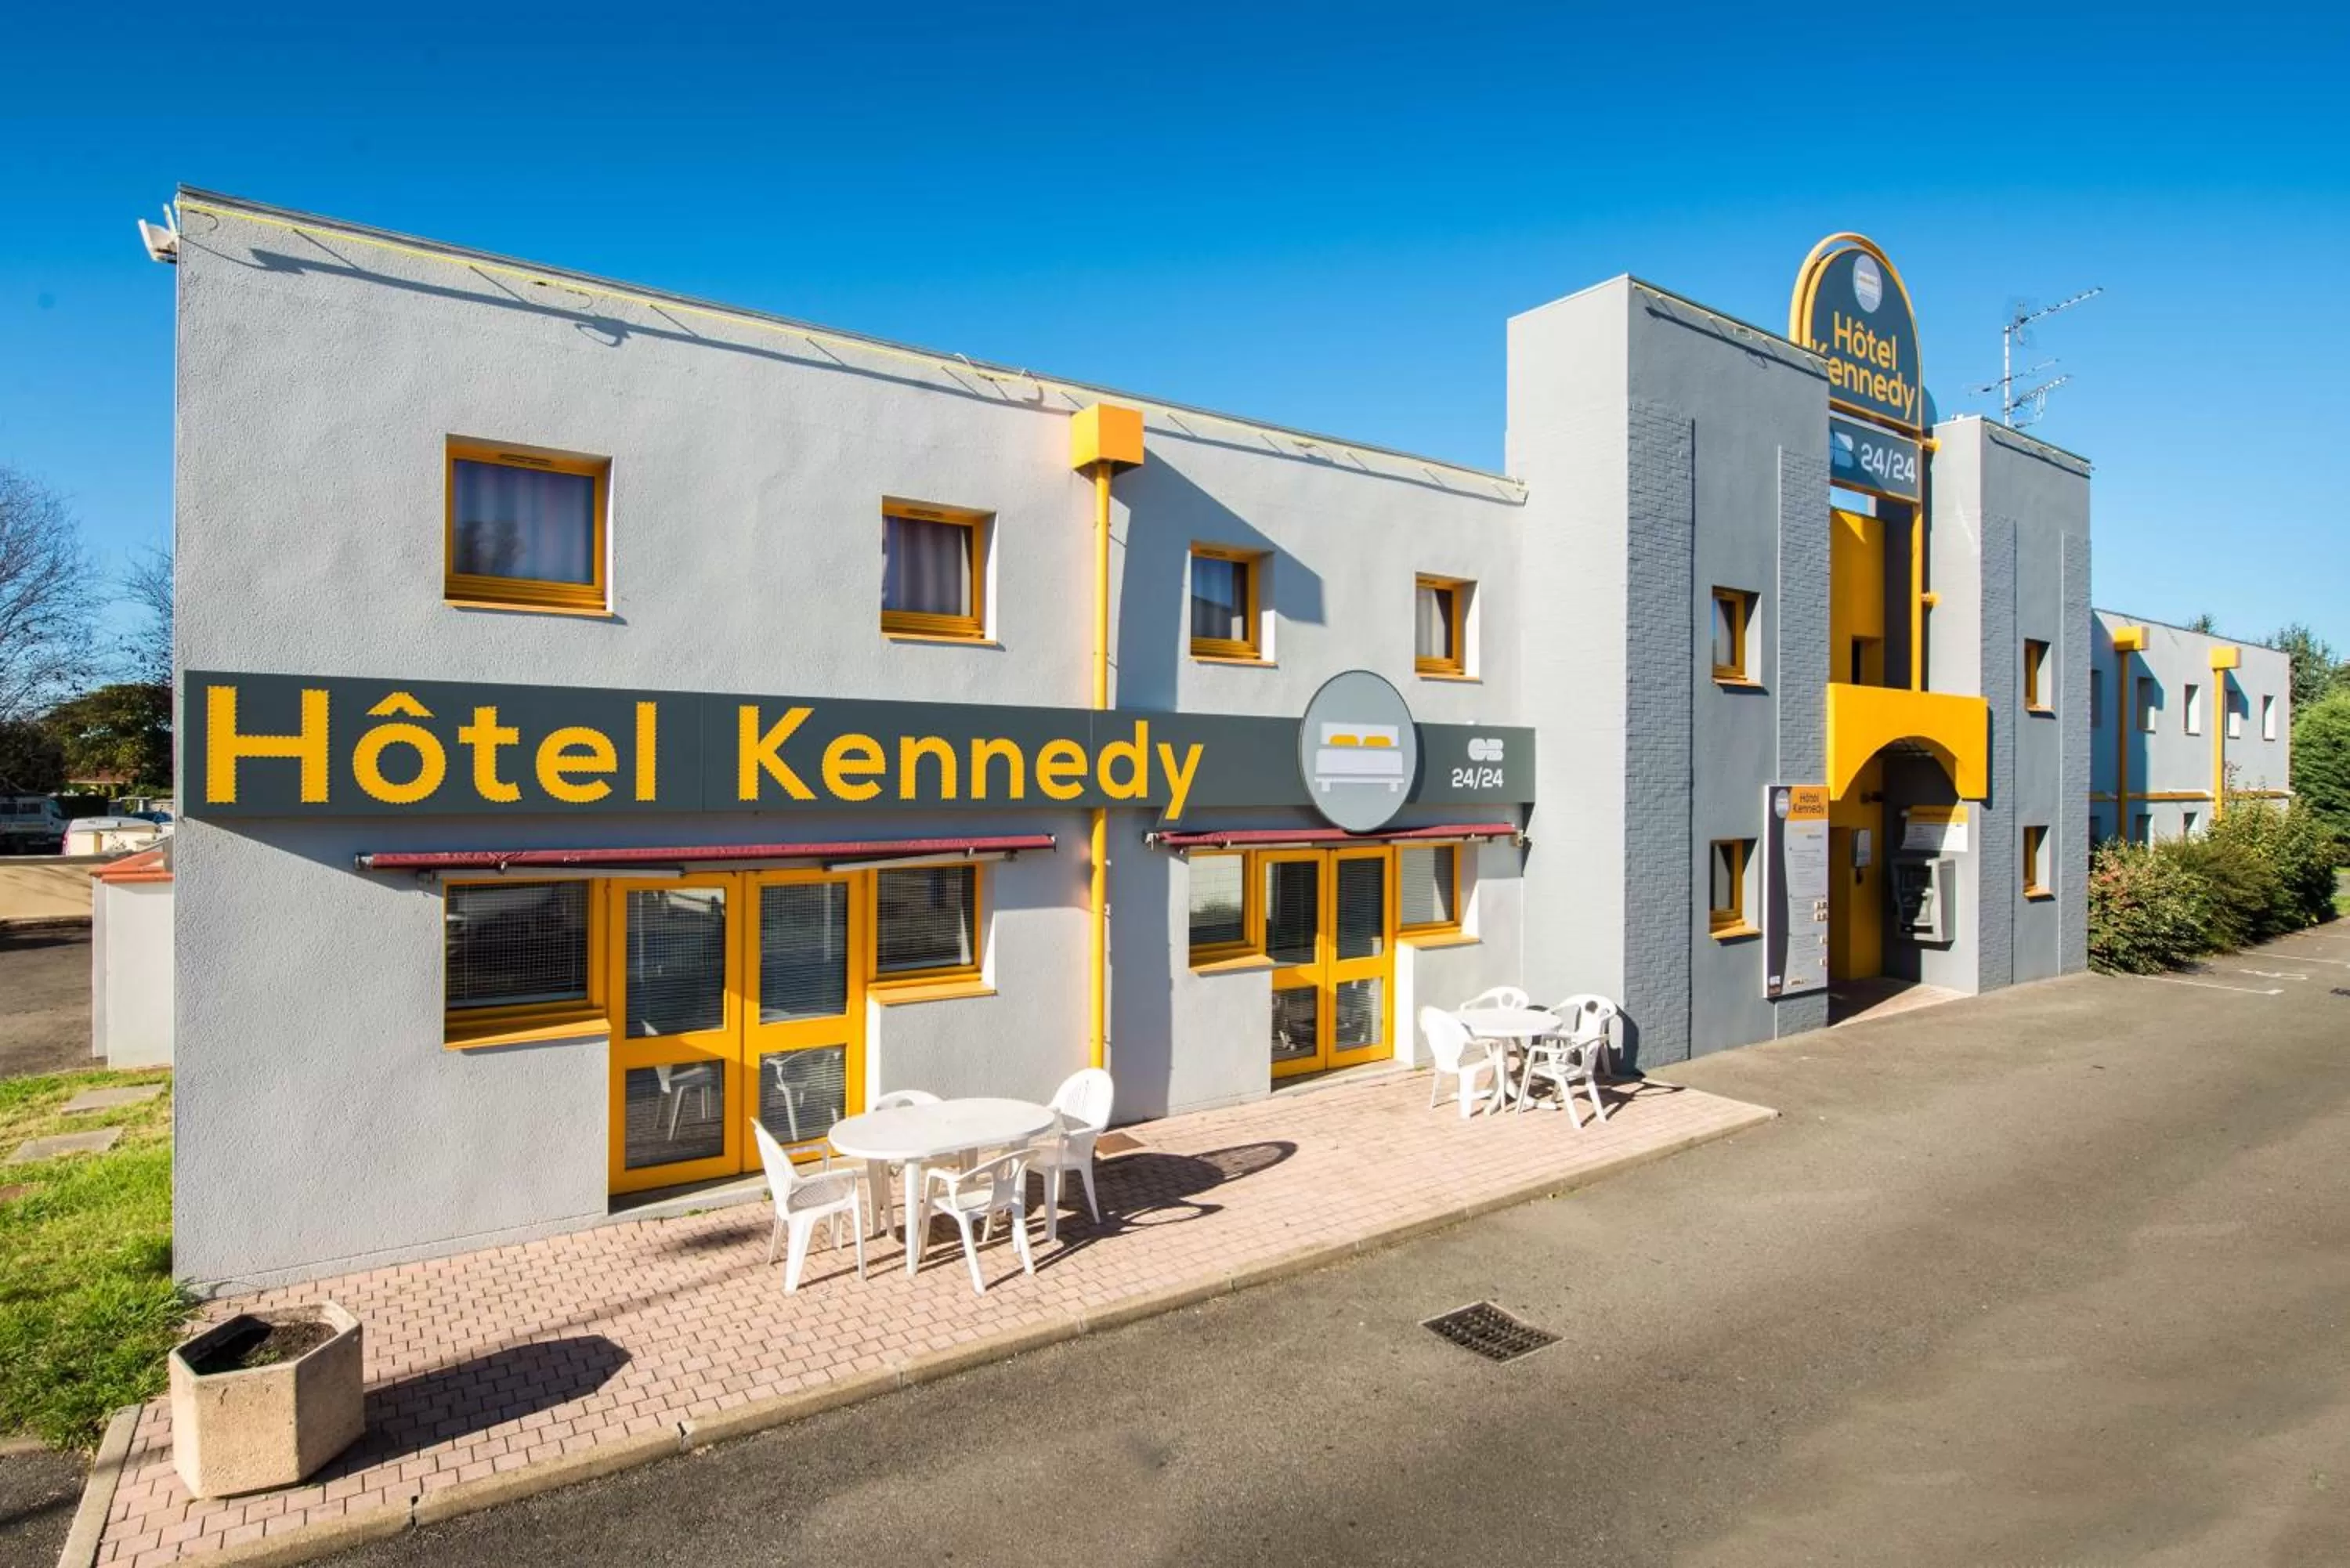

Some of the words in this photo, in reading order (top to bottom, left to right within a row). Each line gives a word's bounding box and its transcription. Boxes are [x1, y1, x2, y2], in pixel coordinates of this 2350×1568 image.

[1833, 311, 1898, 371] Hôtel
[1811, 338, 1916, 421] ennedy
[1860, 443, 1917, 483] 24/24
[206, 685, 657, 804] Hôtel
[739, 706, 1204, 822] Kennedy
[1452, 766, 1505, 790] 24/24
